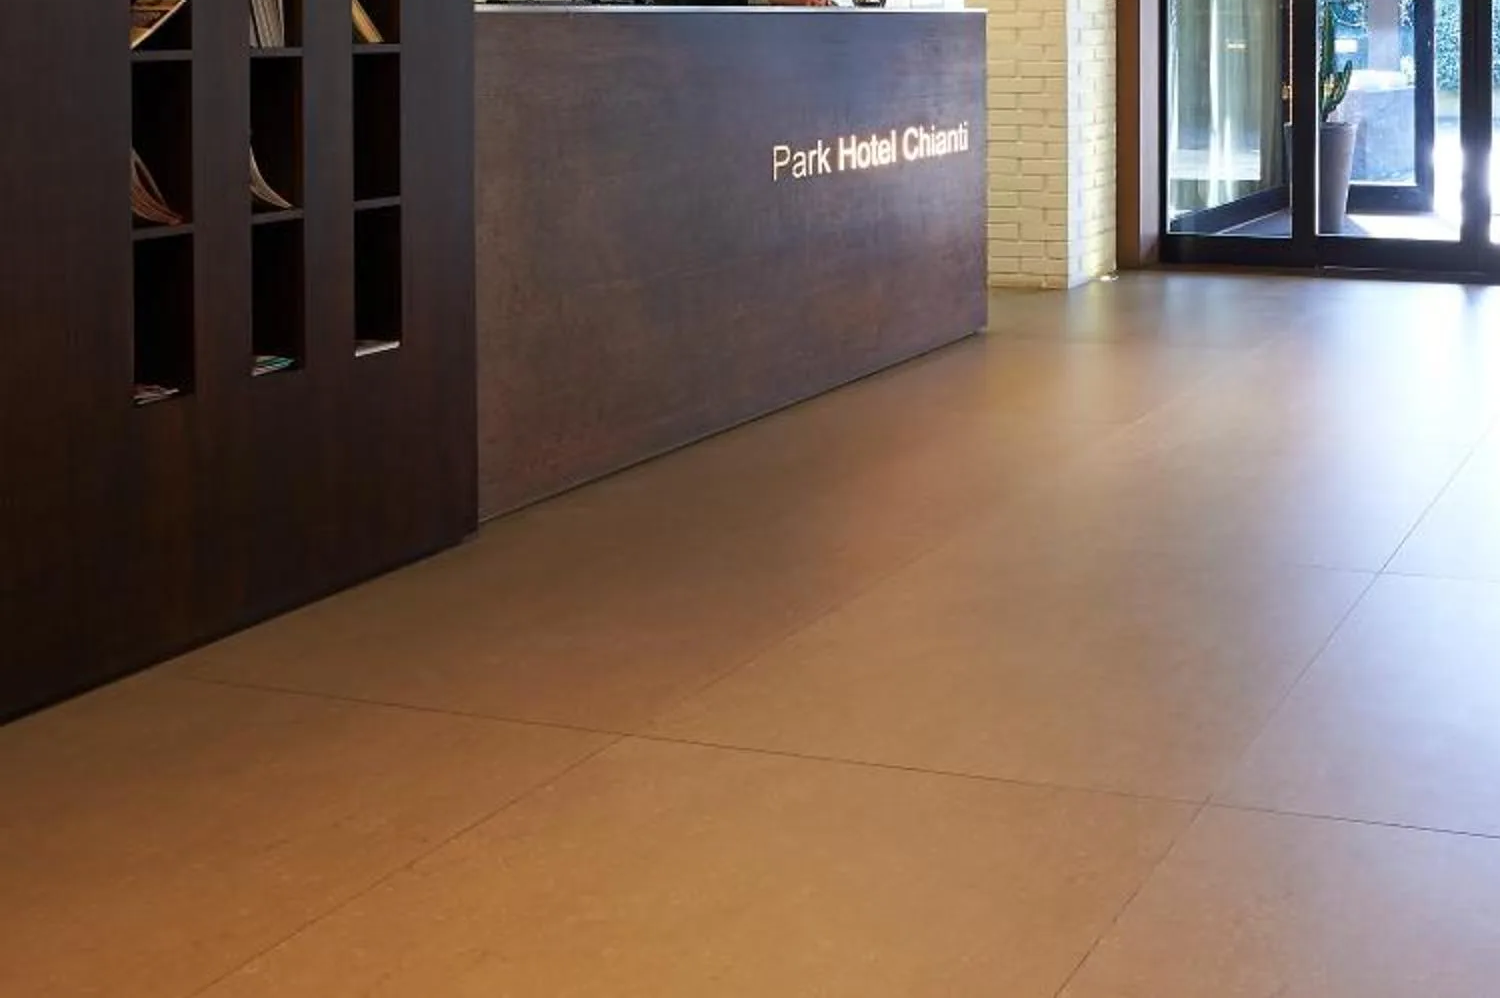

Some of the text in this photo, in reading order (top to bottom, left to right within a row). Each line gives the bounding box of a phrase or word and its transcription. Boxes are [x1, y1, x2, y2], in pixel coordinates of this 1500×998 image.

[773, 121, 969, 181] Park Hotel Chianti
